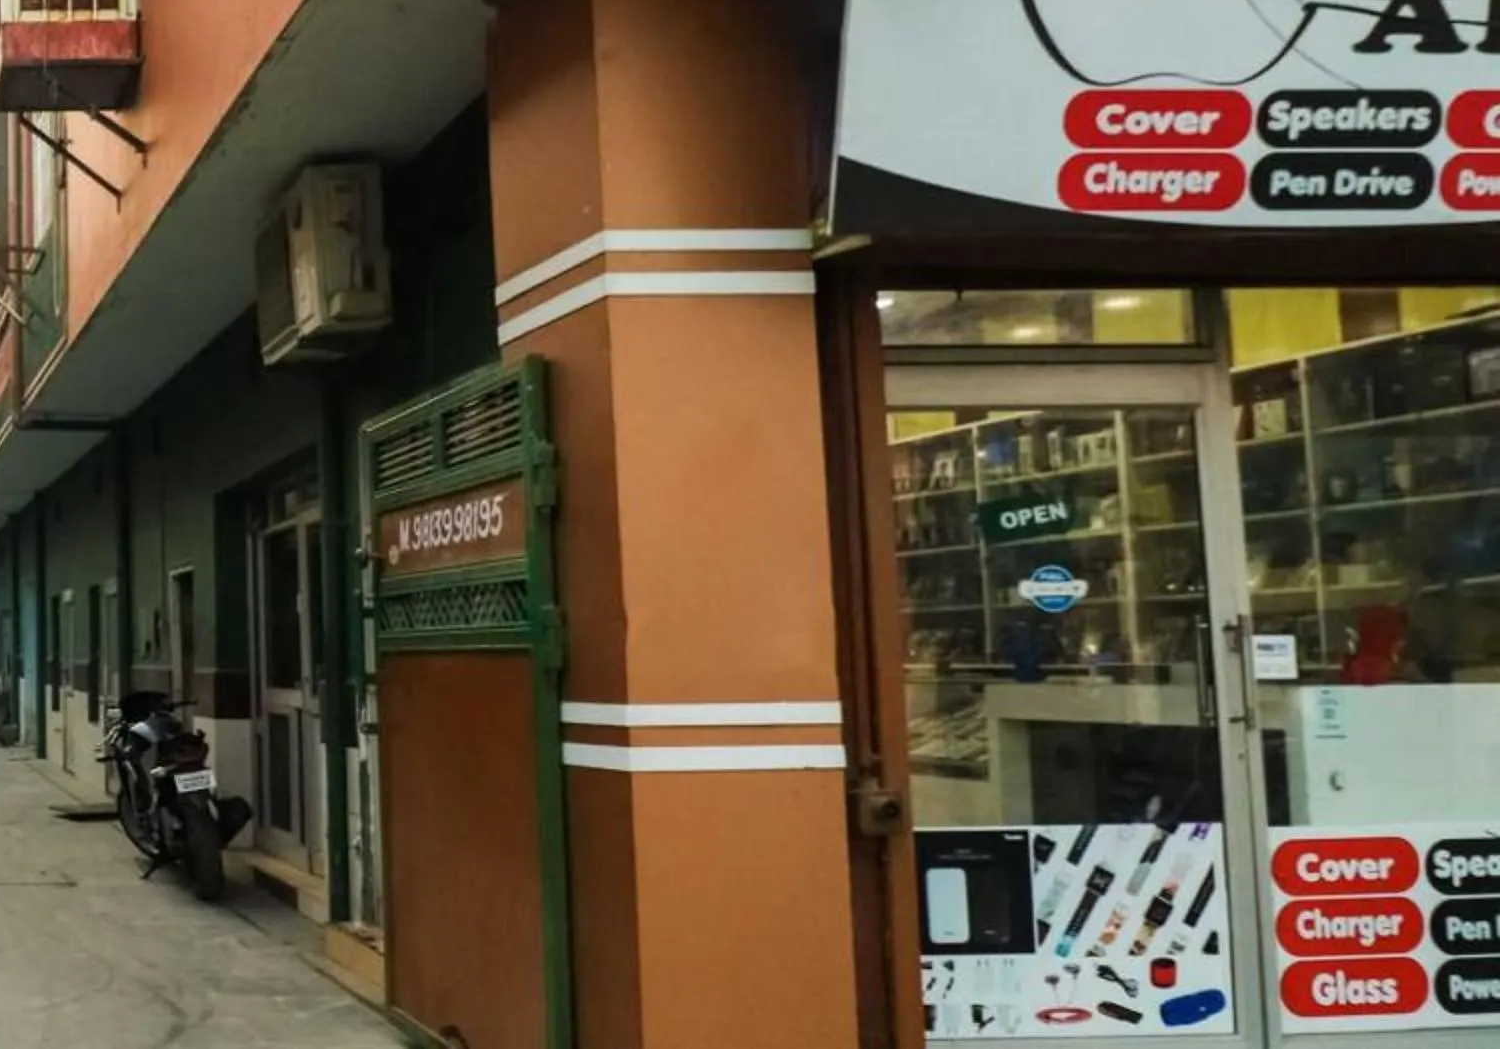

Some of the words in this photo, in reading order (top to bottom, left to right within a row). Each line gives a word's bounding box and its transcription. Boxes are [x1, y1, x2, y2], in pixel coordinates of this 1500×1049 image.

[1096, 104, 1220, 136] Cover
[1267, 98, 1432, 140] Speakers
[1083, 161, 1220, 202] Charger
[1269, 170, 1326, 197] Pen
[1333, 167, 1414, 197] Drive
[1000, 501, 1068, 530] OPEN
[1296, 852, 1395, 882] Cover
[1296, 908, 1404, 947] Charger
[1445, 915, 1492, 941] Pen
[1311, 969, 1400, 1007] Glass
